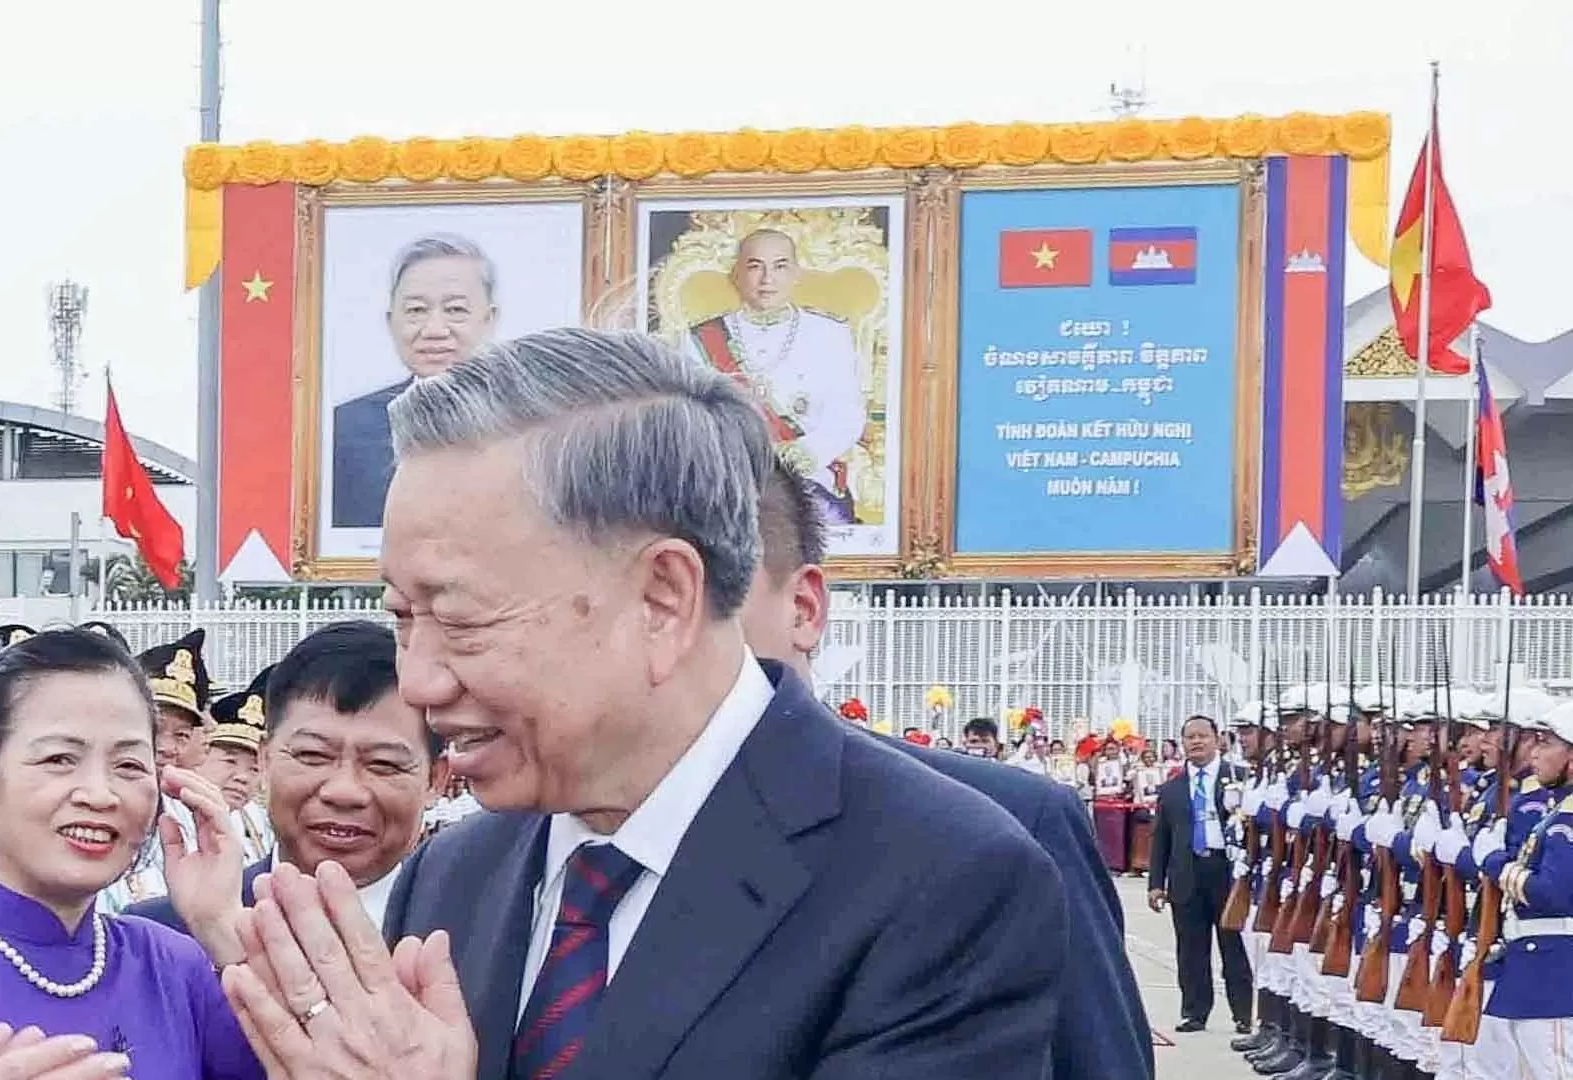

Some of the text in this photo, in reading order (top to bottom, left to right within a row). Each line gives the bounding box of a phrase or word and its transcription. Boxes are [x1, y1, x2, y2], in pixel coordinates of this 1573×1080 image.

[1006, 450, 1042, 472] VIỆT
[1043, 451, 1078, 467] NAM
[1089, 451, 1181, 467] CAMPUCHIA
[1047, 477, 1092, 495] MUÔN
